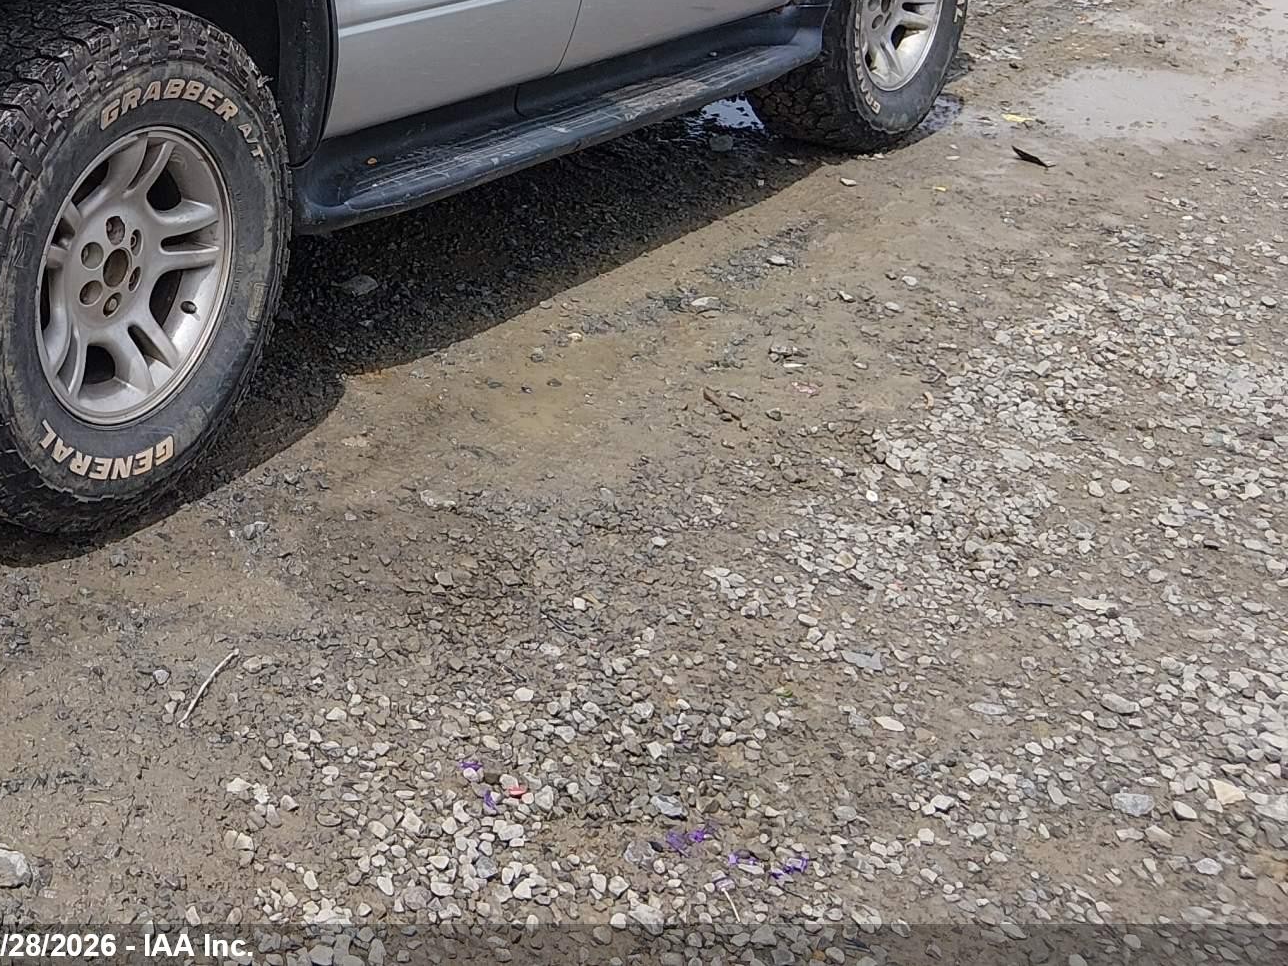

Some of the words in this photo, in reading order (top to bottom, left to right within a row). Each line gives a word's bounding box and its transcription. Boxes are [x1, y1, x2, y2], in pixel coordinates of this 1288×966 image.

[100, 78, 239, 130] GRABBER
[238, 123, 264, 158] A/T
[39, 419, 174, 480] GENERAL
